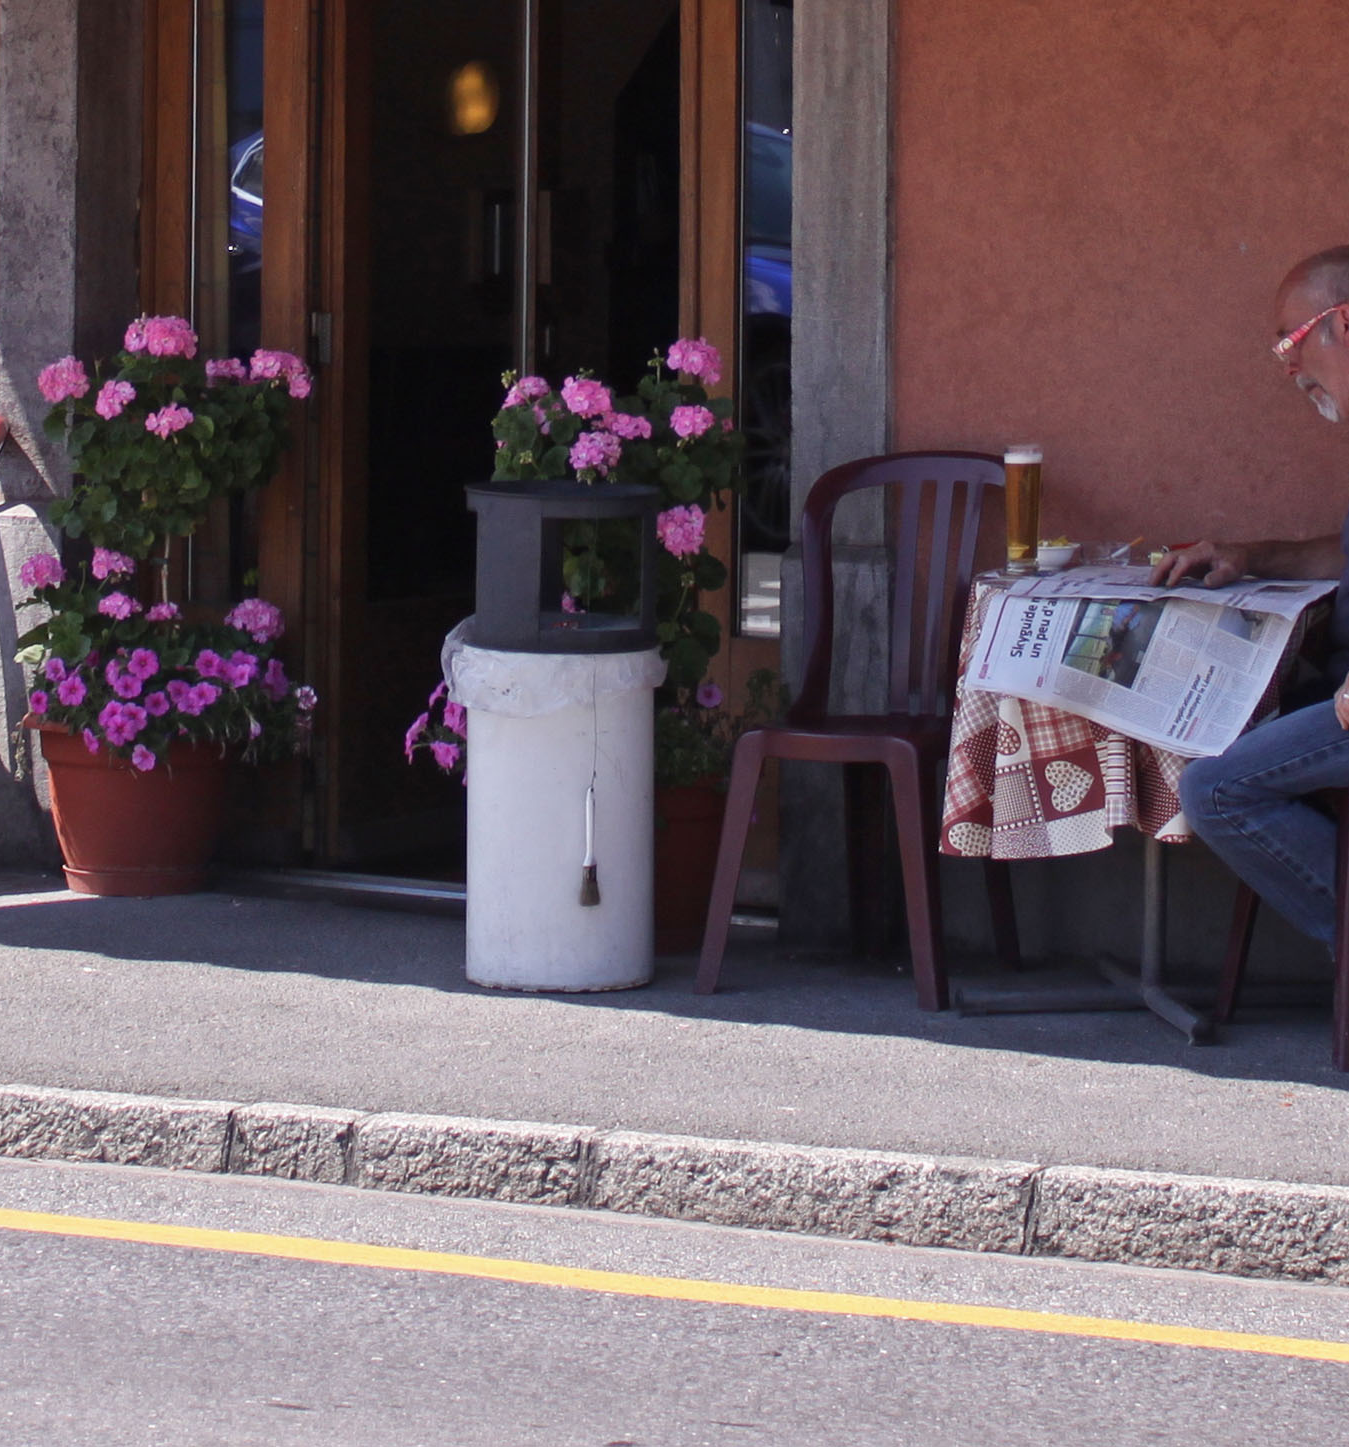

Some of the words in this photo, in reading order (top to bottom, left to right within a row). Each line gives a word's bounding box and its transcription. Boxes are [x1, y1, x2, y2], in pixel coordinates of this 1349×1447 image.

[1010, 604, 1038, 658] Skyguide
[1036, 619, 1050, 641] peu
[1030, 643, 1043, 658] un
